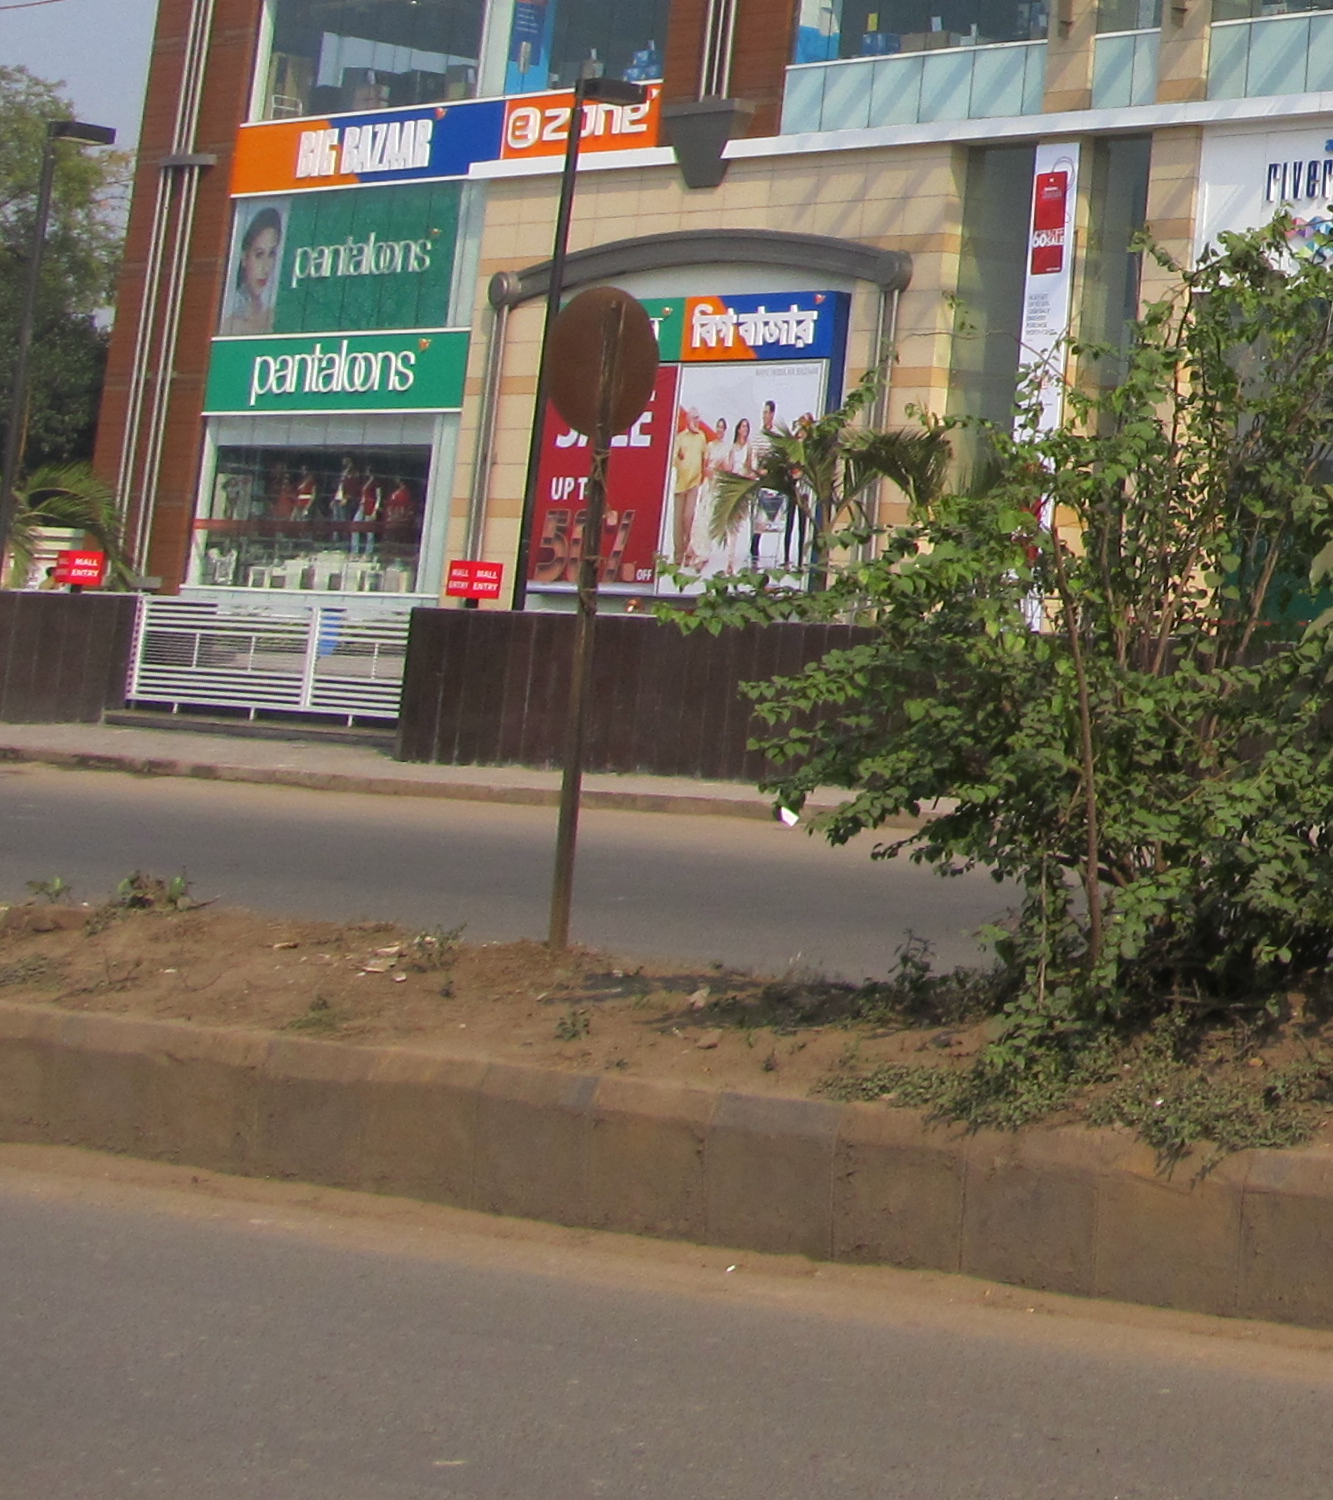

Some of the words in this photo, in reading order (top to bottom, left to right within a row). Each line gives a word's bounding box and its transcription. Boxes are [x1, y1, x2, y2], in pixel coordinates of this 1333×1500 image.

[296, 128, 339, 178] BIG
[340, 119, 433, 176] BAZAAR
[291, 232, 432, 289] pantaloons
[738, 304, 818, 348] বাজার
[250, 339, 416, 407] pantaloons
[551, 476, 574, 500] UP
[636, 568, 653, 581] OFF
